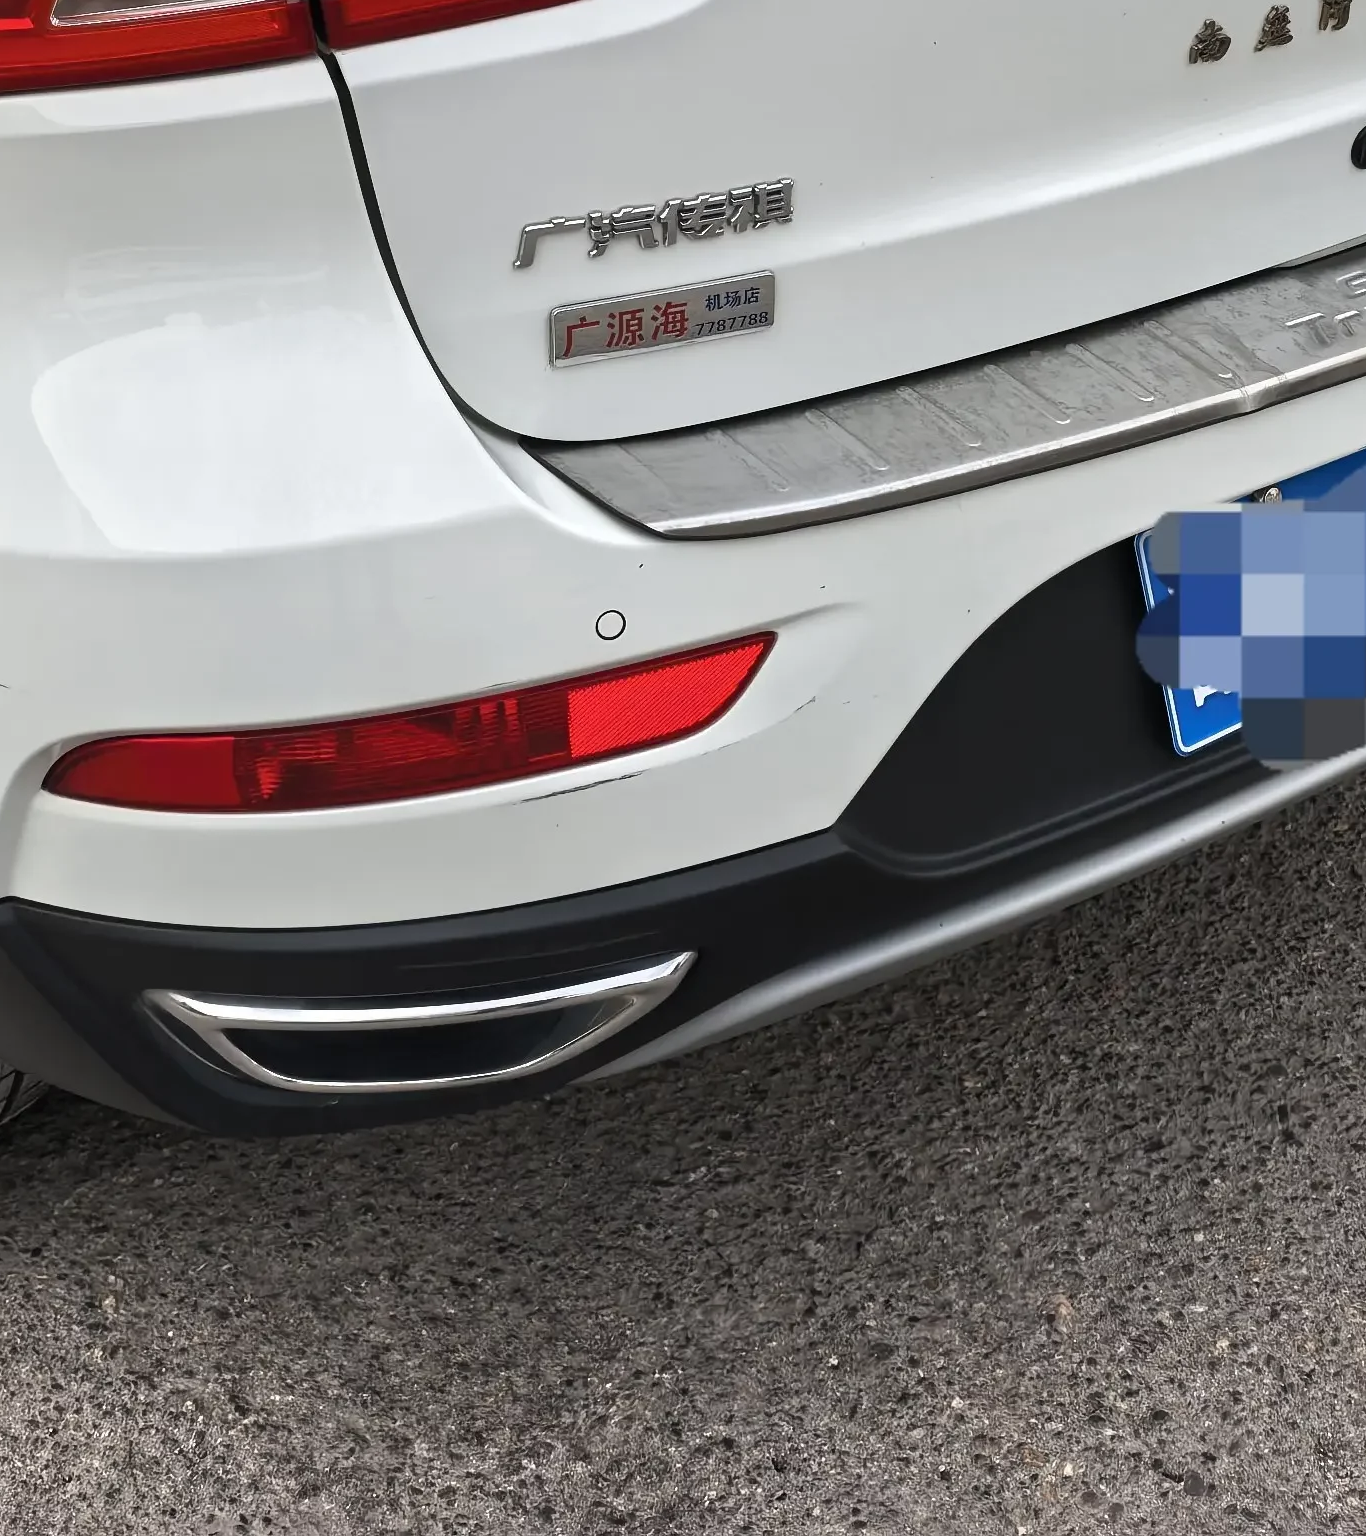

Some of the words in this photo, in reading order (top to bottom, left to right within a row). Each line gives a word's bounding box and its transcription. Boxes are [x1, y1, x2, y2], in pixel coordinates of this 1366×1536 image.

[513, 177, 794, 269] 广汽传祺
[704, 286, 761, 312] 机场店
[562, 300, 690, 358] 广源海
[694, 312, 770, 337] 7787788
